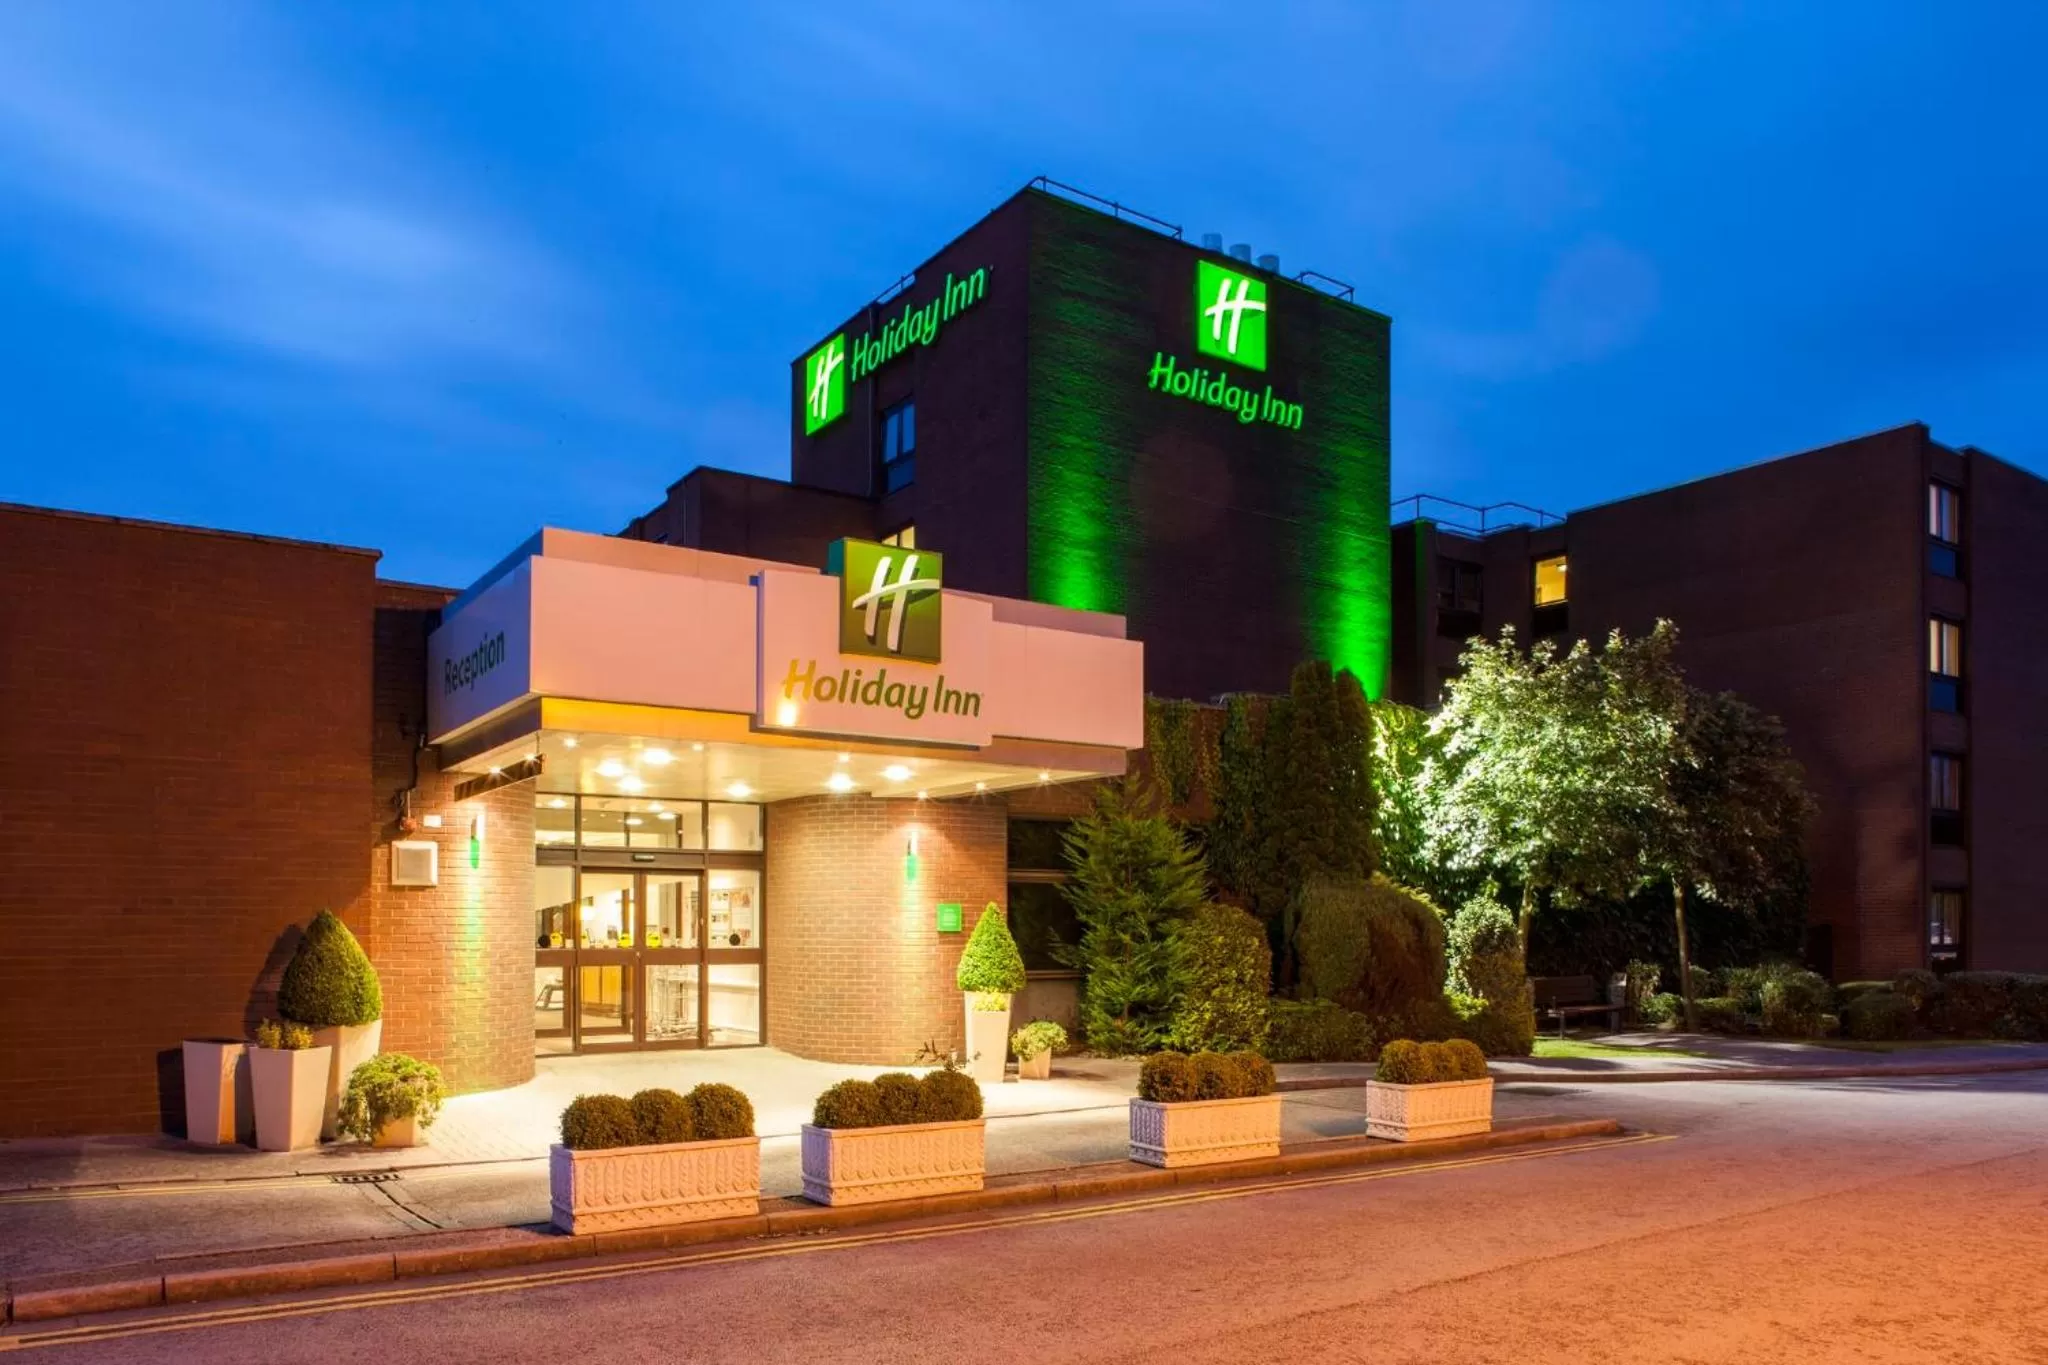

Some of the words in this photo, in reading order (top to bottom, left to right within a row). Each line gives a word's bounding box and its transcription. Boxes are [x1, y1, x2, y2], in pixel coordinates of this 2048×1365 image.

[852, 298, 941, 382] Holiday
[943, 268, 985, 321] Inn
[1148, 352, 1259, 423] Holiday
[1263, 385, 1304, 429] Inn
[444, 631, 504, 696] Reception
[783, 659, 929, 719] Holiday
[933, 675, 981, 717] Inn
